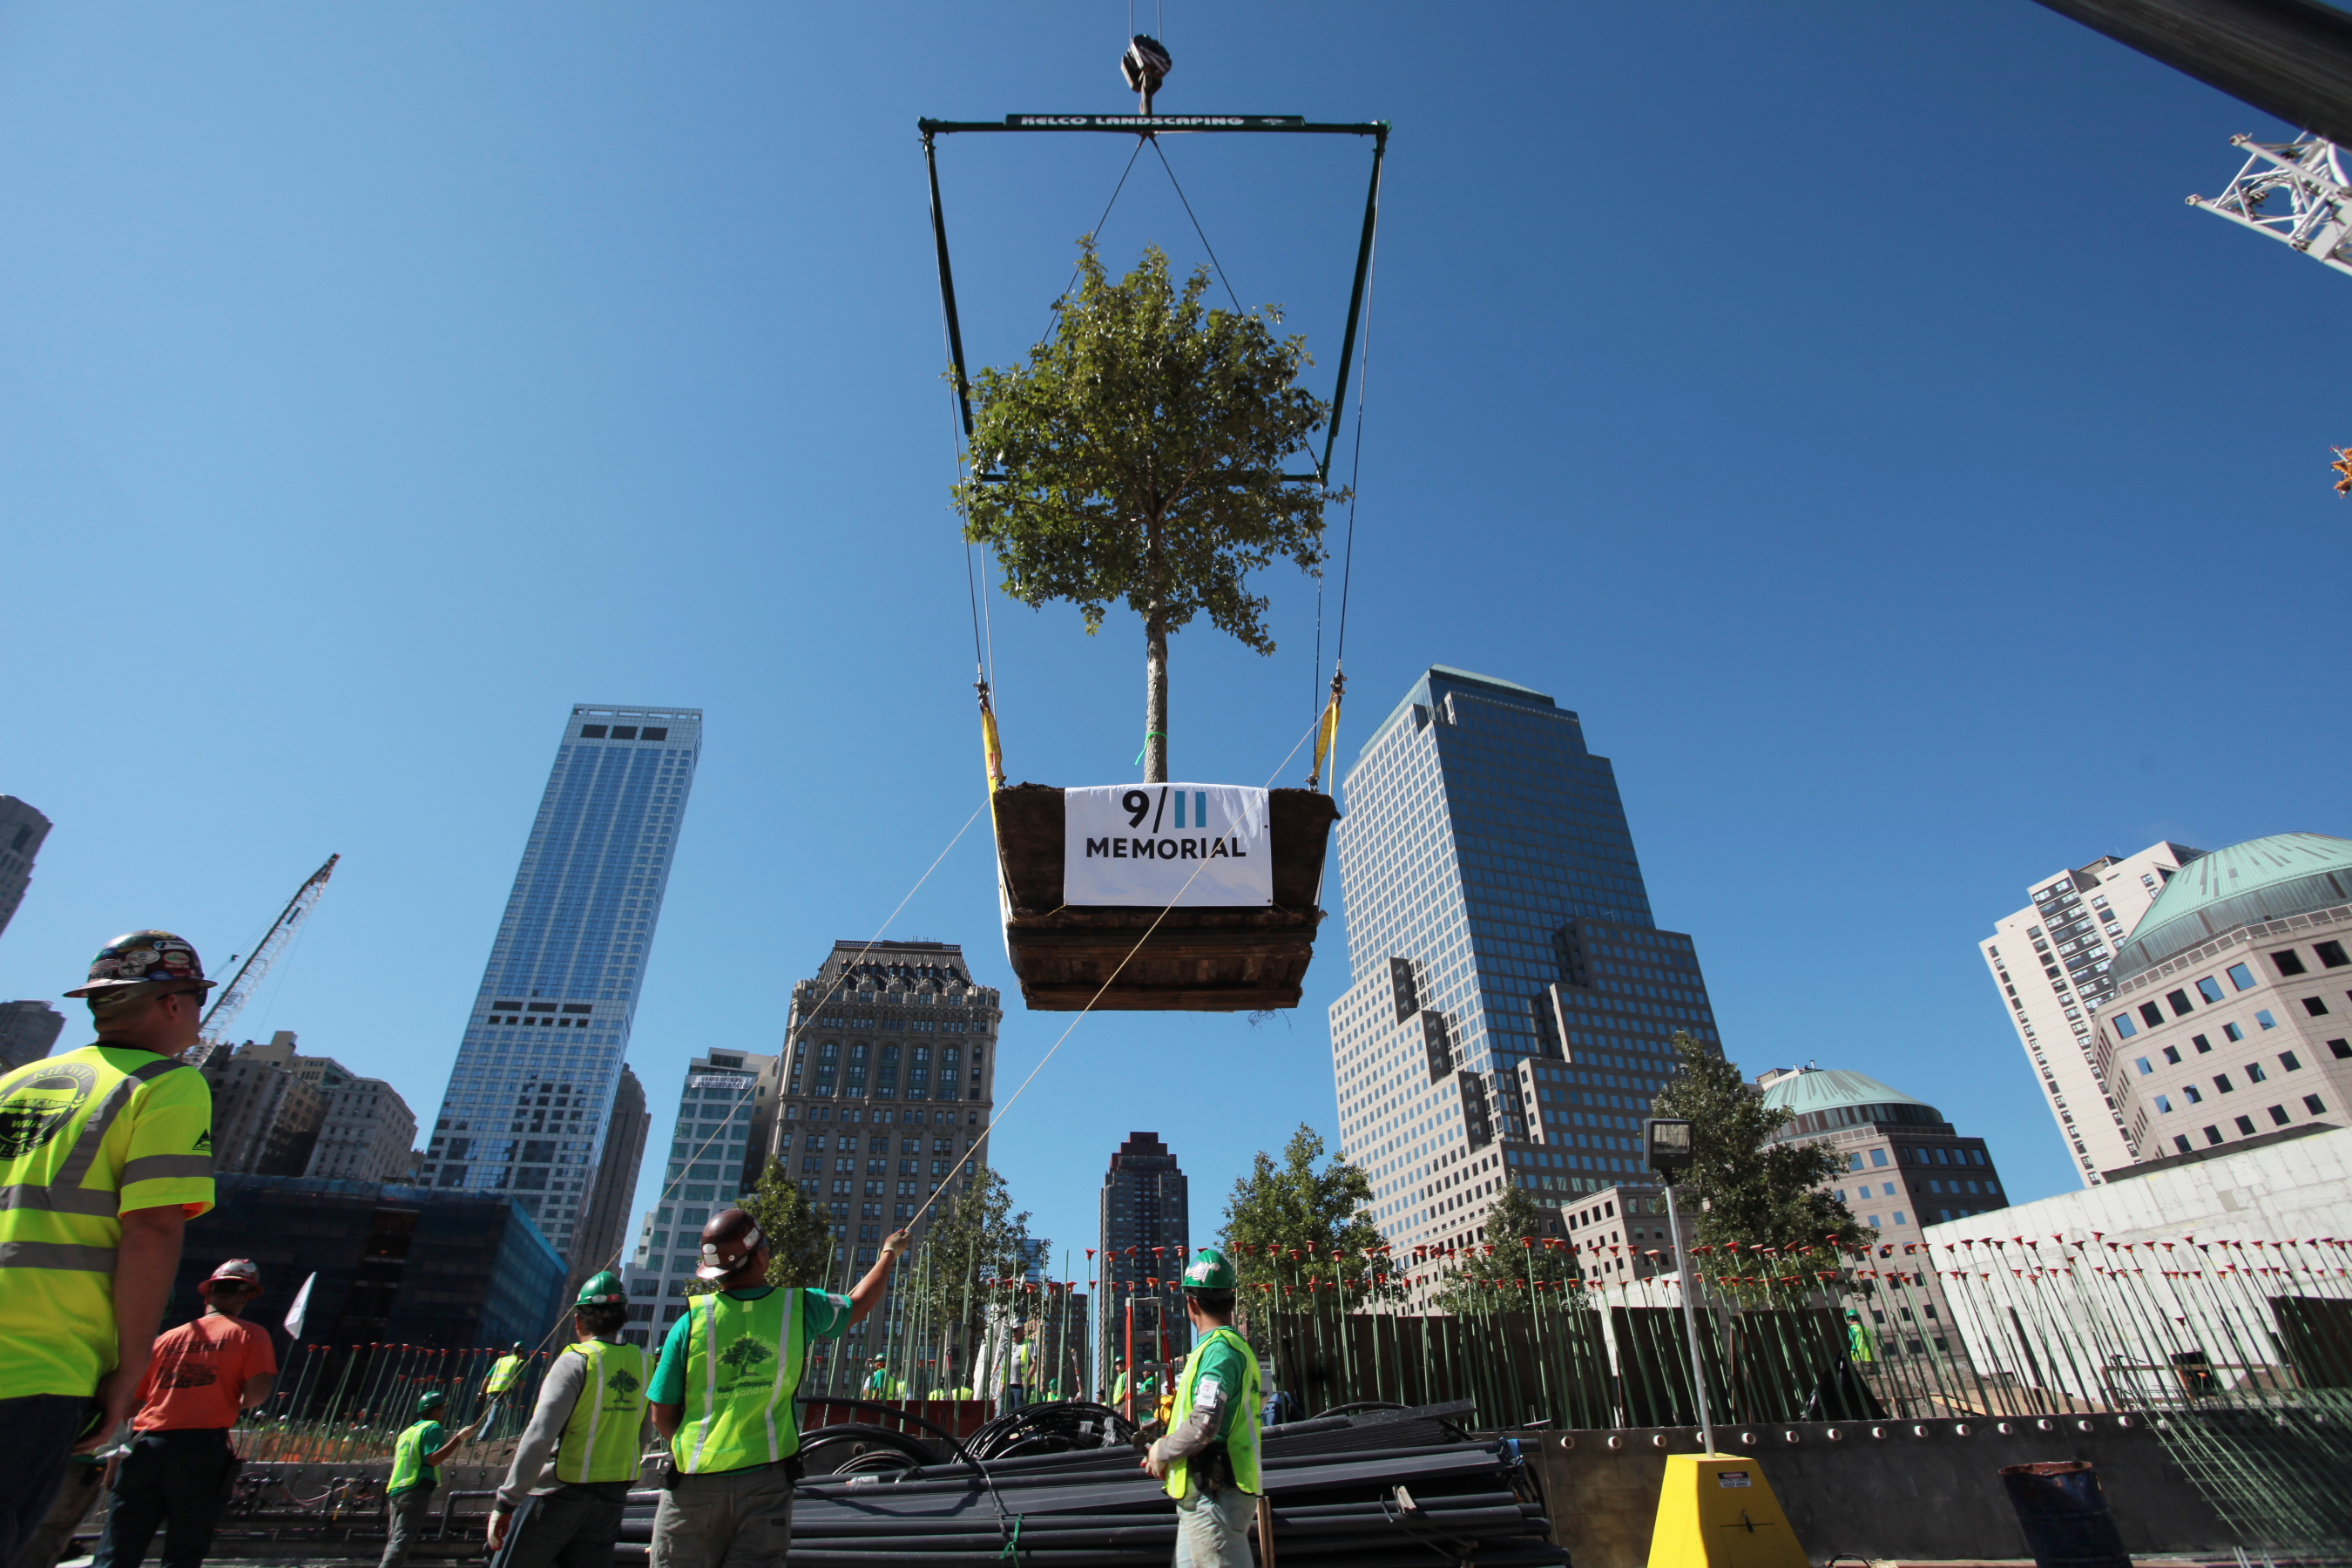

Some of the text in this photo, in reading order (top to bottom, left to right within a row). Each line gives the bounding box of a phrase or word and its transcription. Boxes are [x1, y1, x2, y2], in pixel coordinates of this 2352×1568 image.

[1021, 116, 1244, 125] KELCO LANDSCAPING
[1122, 786, 1206, 834] 9/11
[1085, 836, 1247, 860] MEMORIAL
[11, 1119, 44, 1128] Willis
[735, 1379, 773, 1389] andscaping
